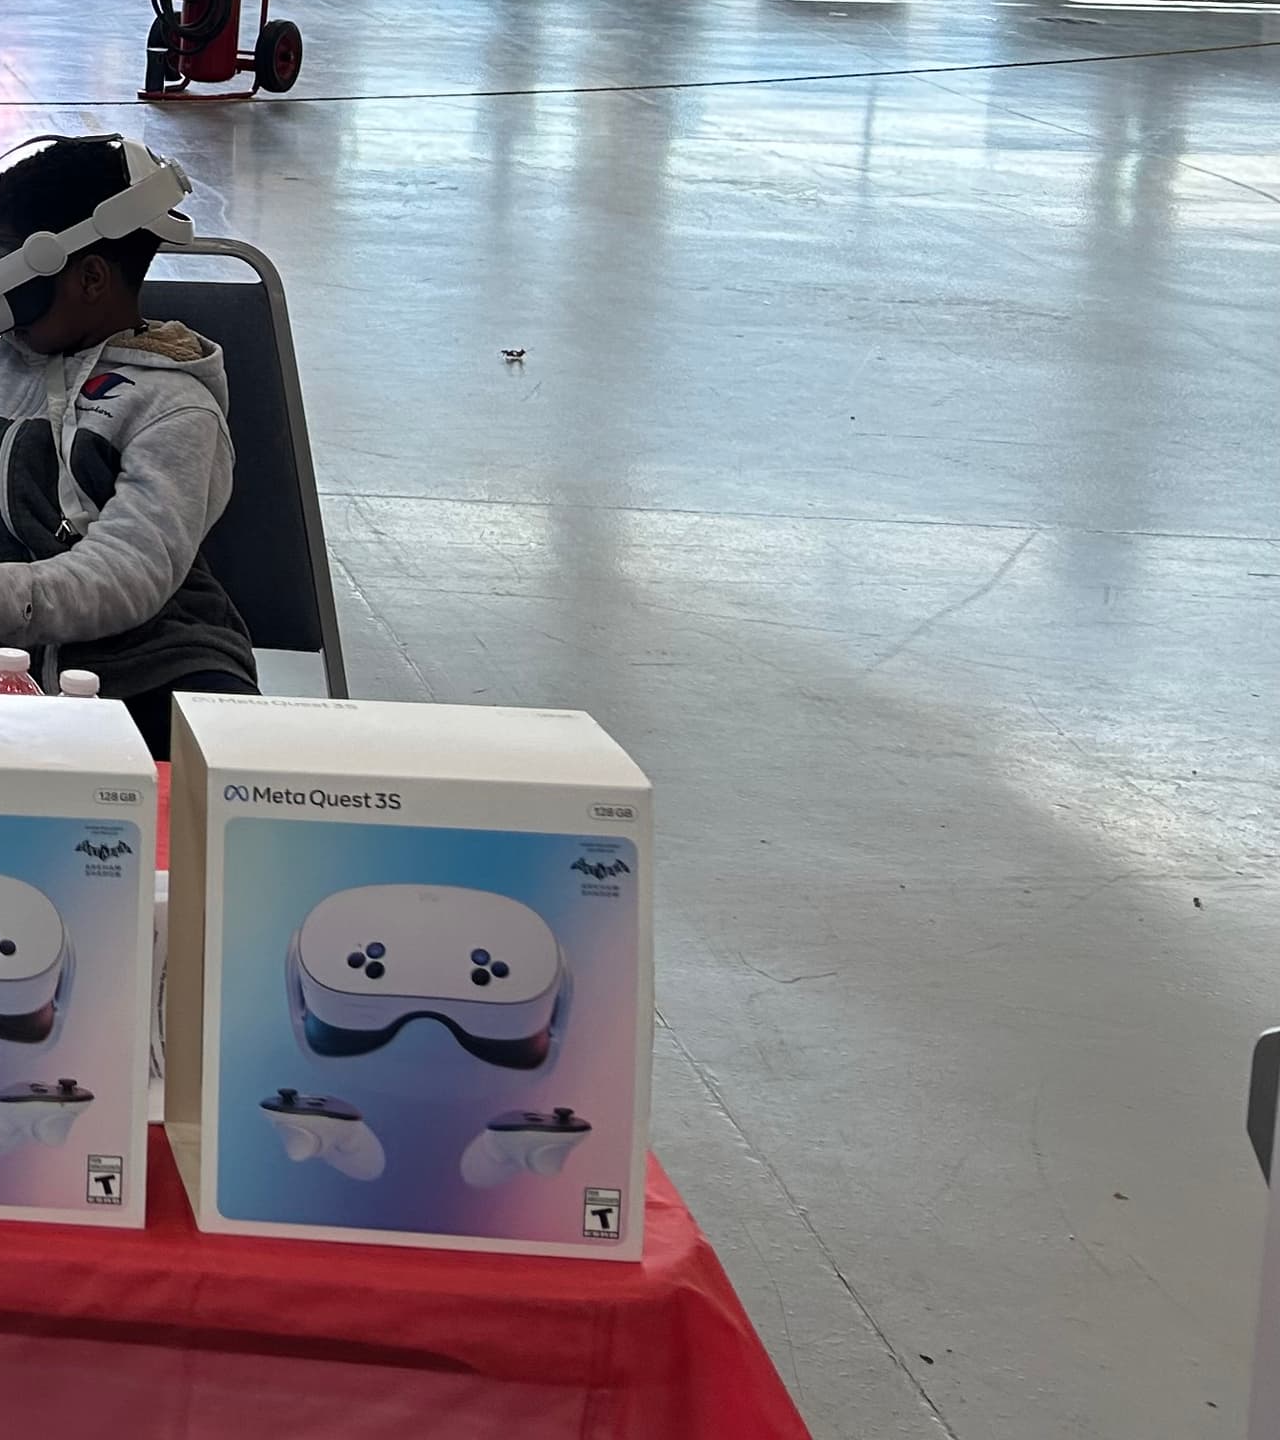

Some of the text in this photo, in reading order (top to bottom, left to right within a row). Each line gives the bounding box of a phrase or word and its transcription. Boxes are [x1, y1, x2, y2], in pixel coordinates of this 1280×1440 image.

[99, 791, 137, 801] 128 GB
[252, 786, 402, 810] Meta Quest 3S
[94, 1174, 116, 1196] T
[591, 1207, 613, 1229] T
